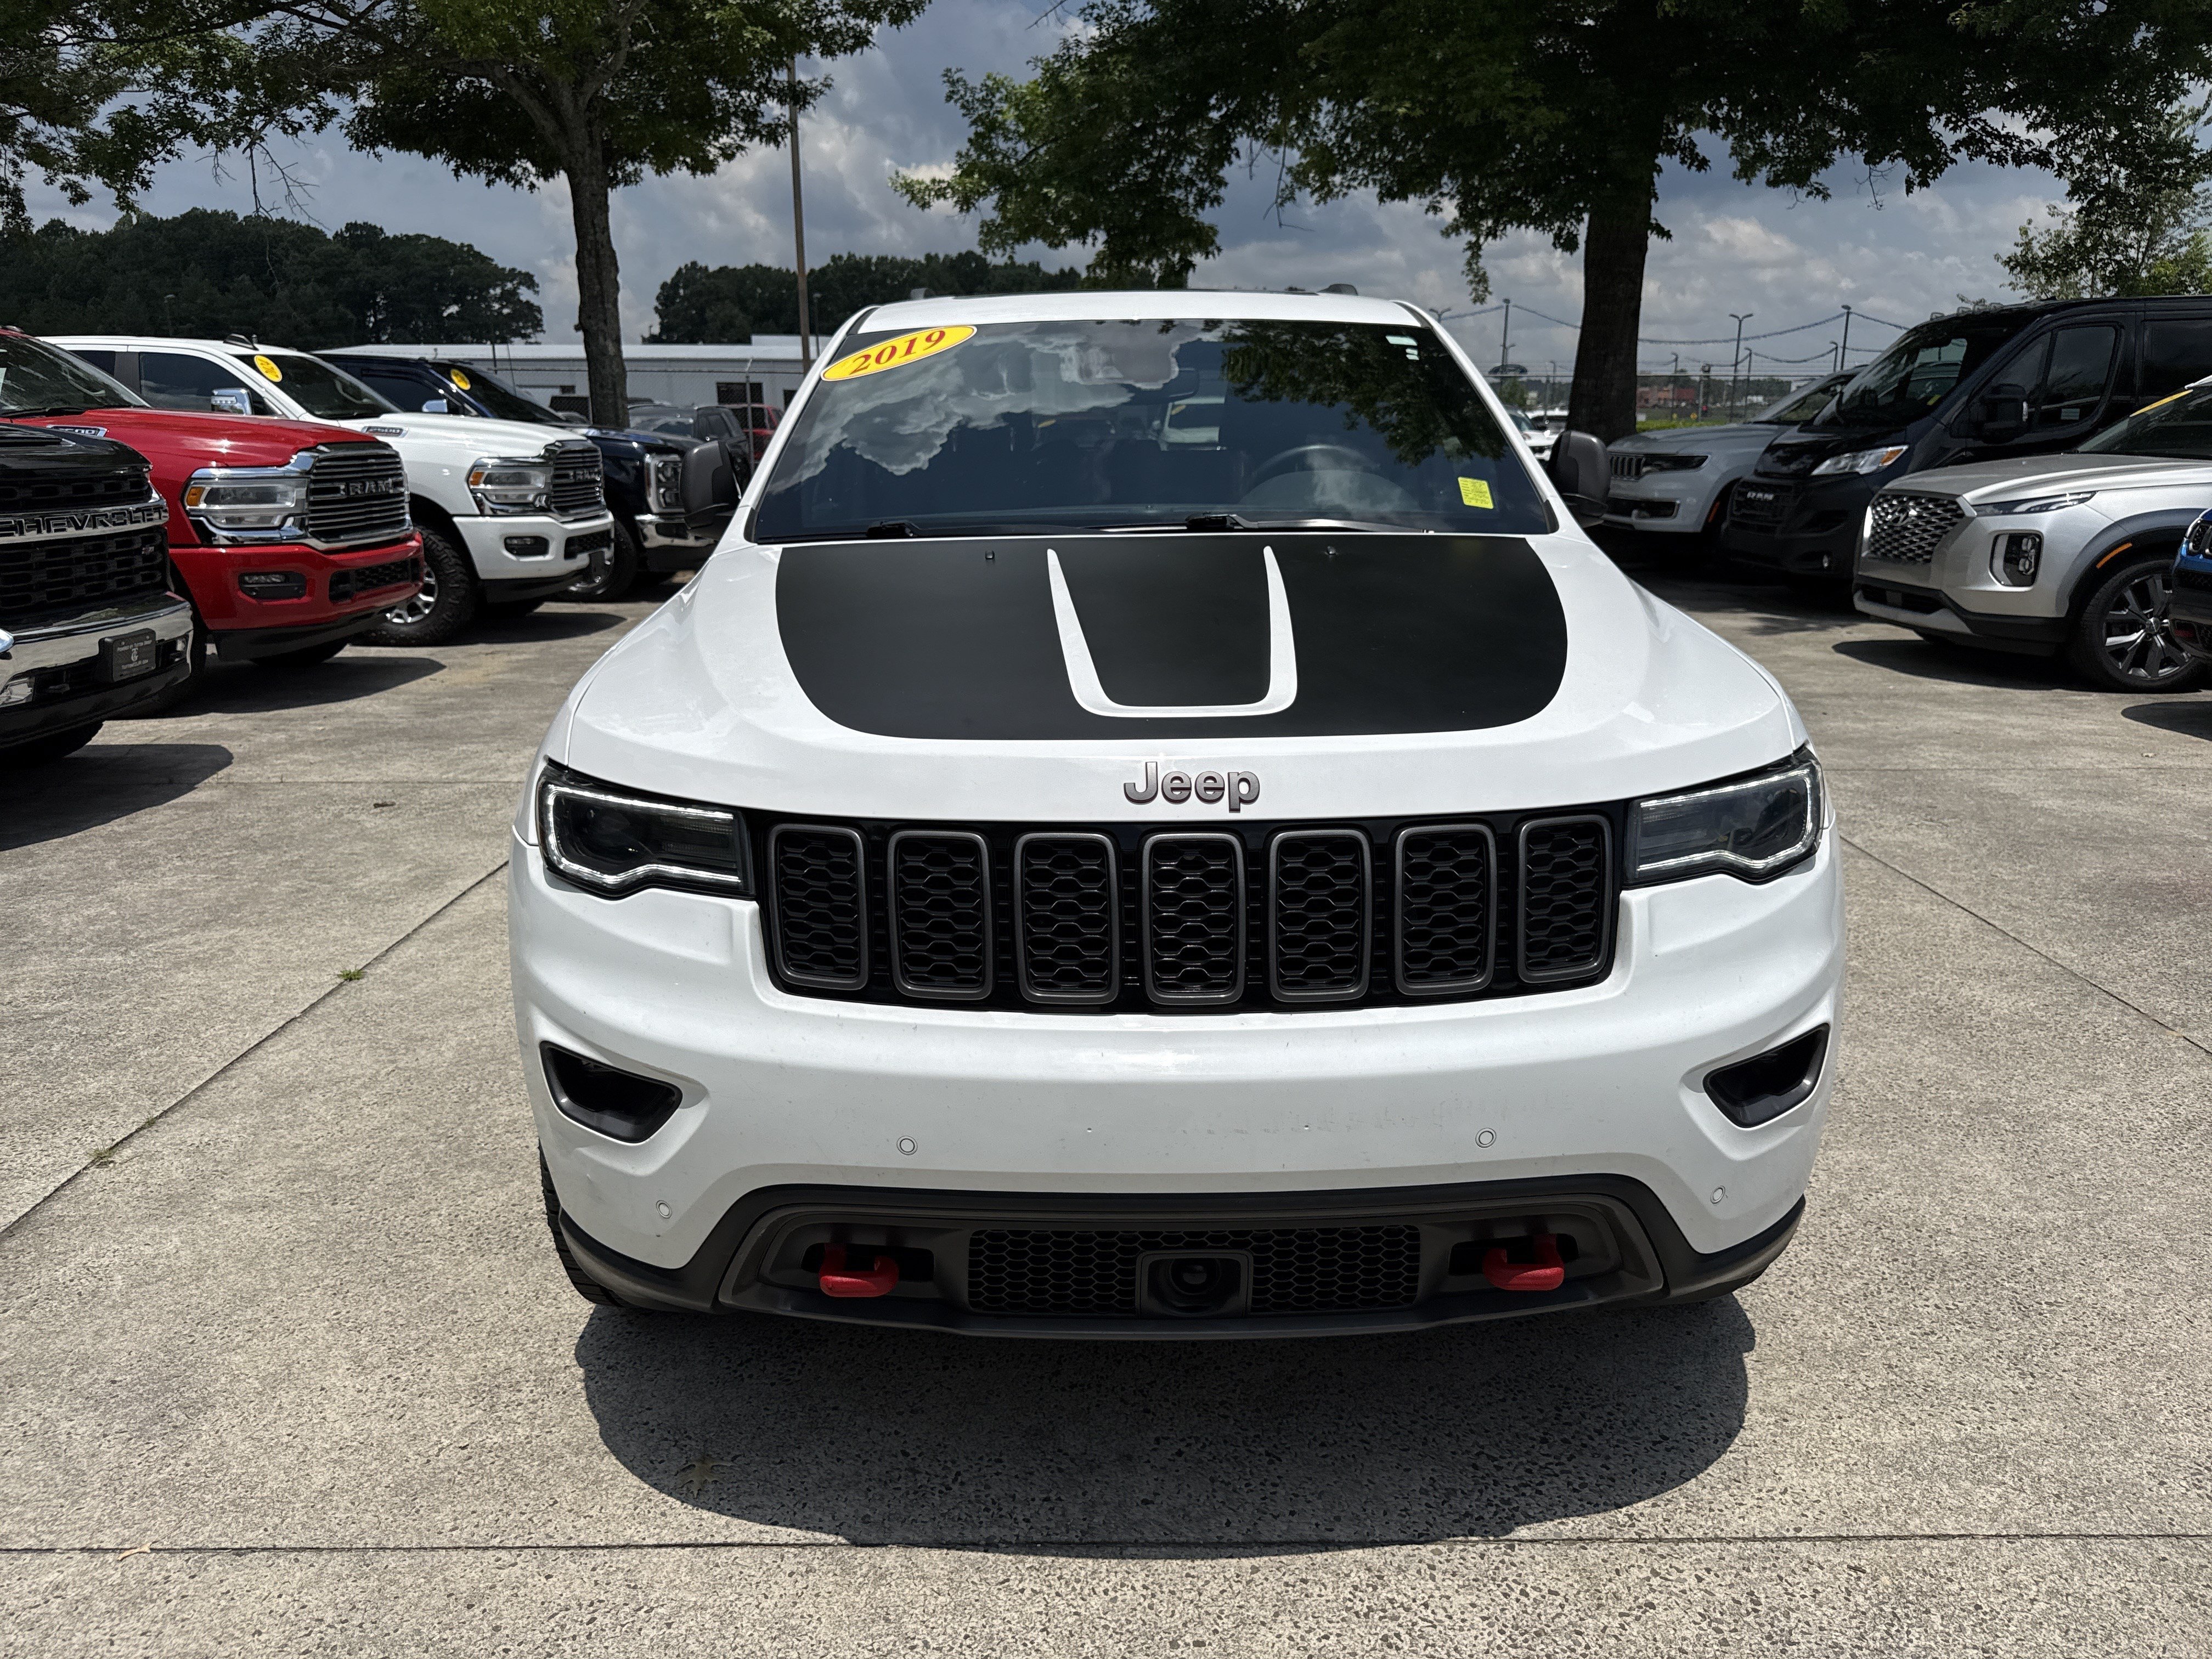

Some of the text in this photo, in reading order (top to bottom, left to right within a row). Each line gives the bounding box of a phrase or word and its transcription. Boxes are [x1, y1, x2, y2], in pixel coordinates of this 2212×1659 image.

[849, 330, 946, 376] 2019
[349, 478, 393, 495] RAM
[1124, 761, 1260, 813] Jeep
